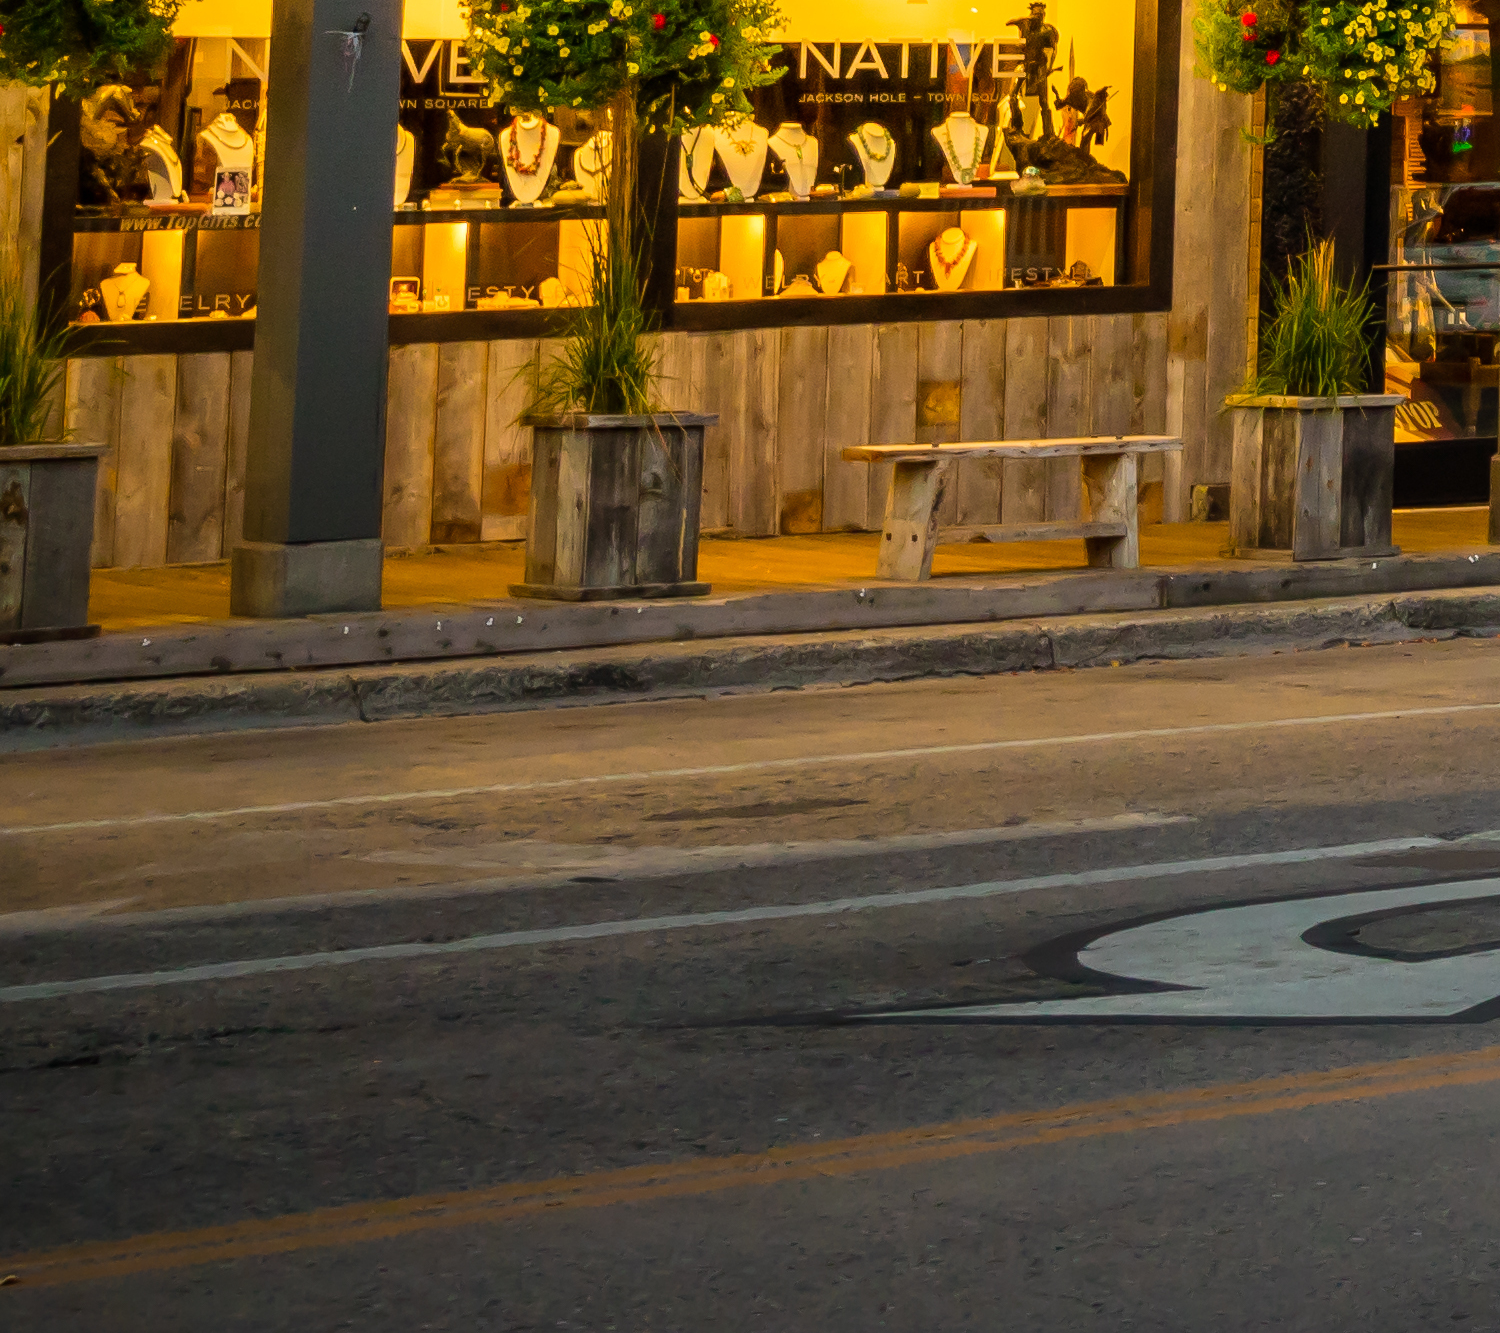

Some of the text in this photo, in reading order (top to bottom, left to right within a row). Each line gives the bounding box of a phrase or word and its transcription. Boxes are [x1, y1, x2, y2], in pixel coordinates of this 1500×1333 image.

[799, 37, 1027, 80] NATIVE
[799, 93, 865, 104] JACKSON
[869, 92, 906, 103] HOLE
[928, 92, 966, 103] TOWN
